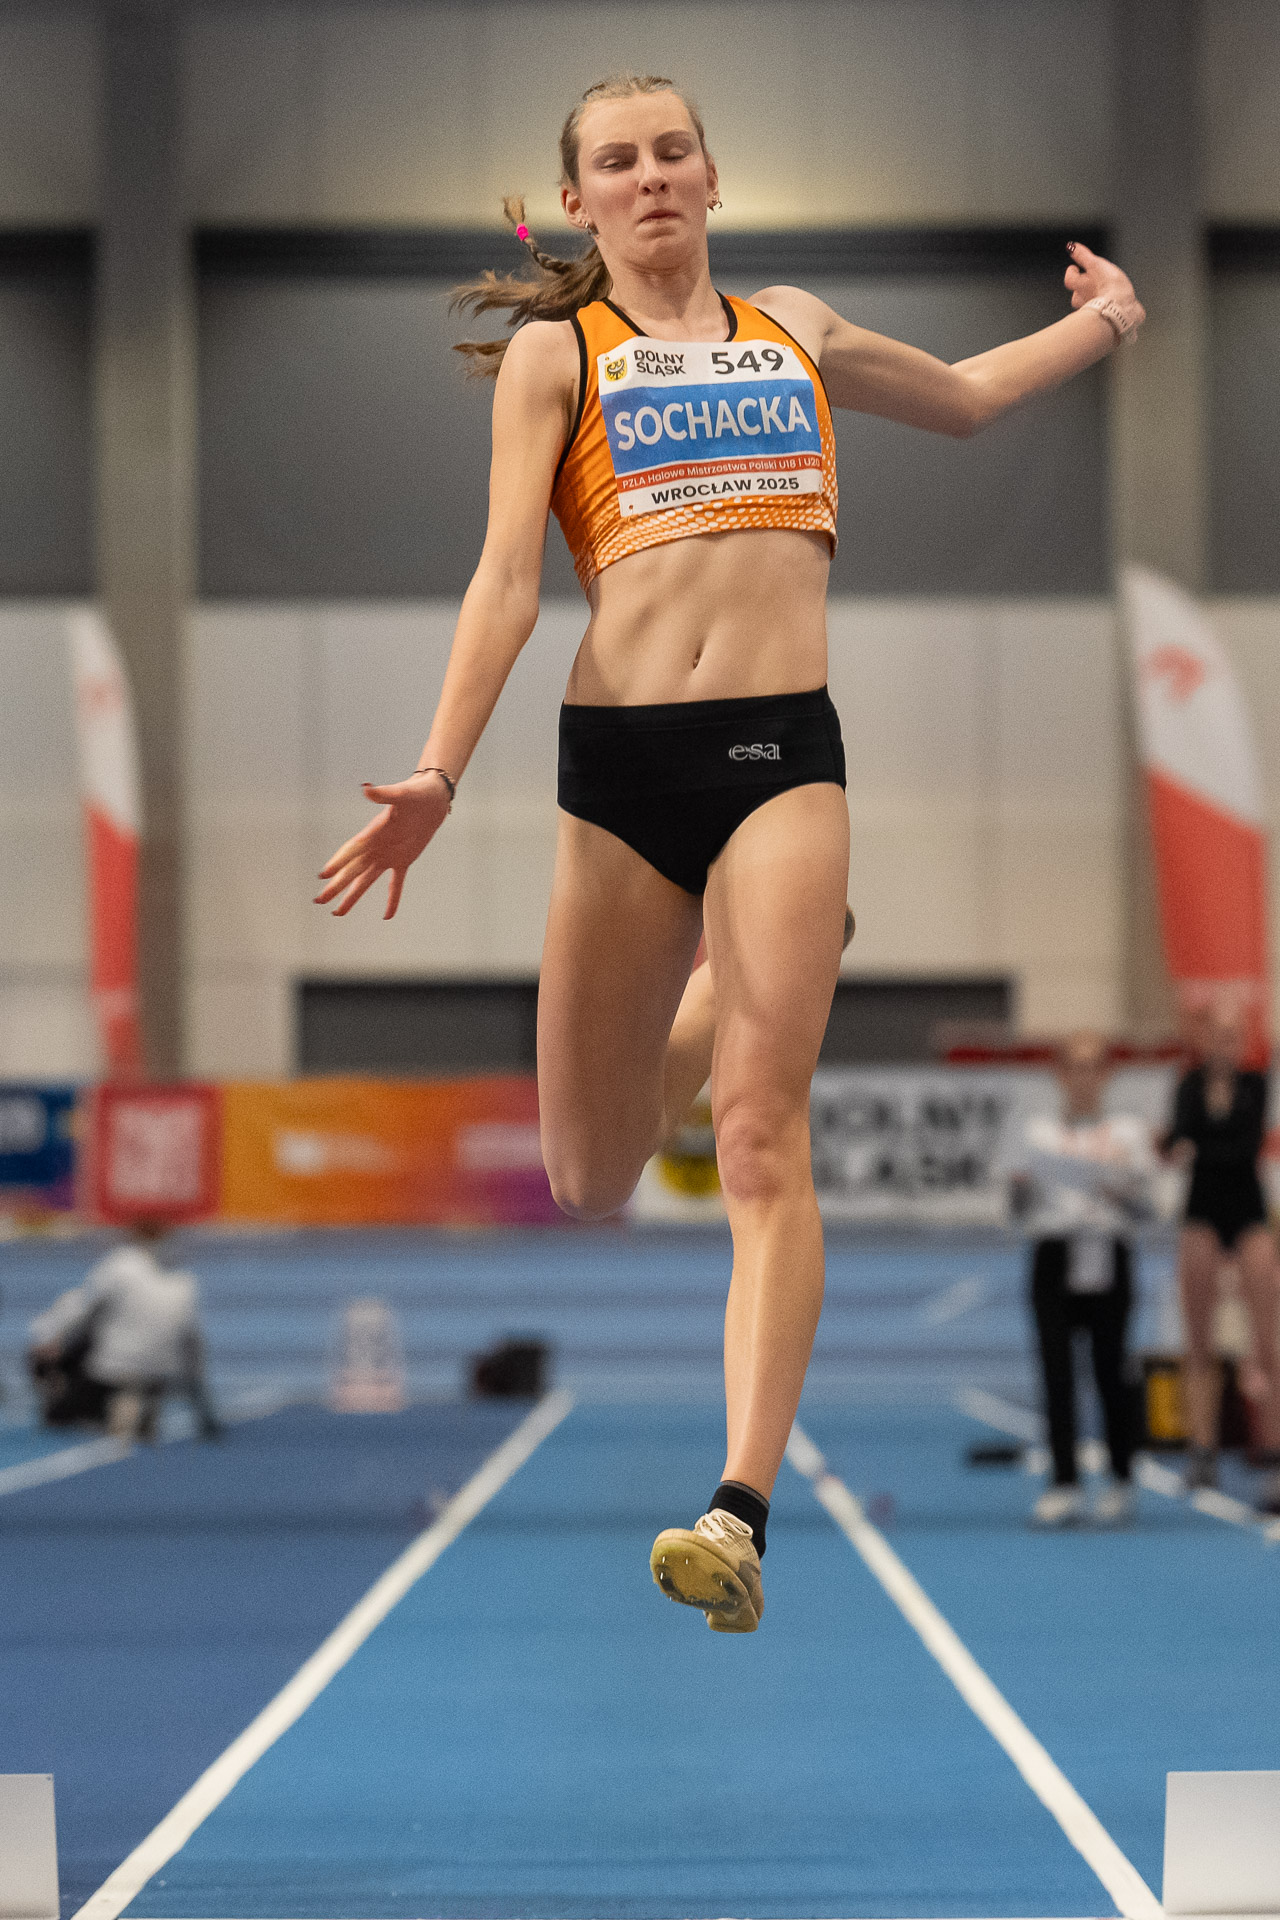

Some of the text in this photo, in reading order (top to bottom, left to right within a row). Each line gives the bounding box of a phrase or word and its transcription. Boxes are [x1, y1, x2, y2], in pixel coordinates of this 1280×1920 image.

[634, 349, 684, 364] DOLNY
[711, 348, 784, 375] 549
[614, 395, 812, 451] SOCHACKA
[622, 477, 646, 489] PZLA
[647, 468, 685, 484] Halowe
[687, 462, 747, 476] Mistrzostwa
[748, 460, 777, 470] Polski
[778, 458, 796, 469] U18
[803, 457, 820, 468] U20
[651, 477, 800, 504] WROCŁAW 2025
[728, 743, 782, 761] esa
